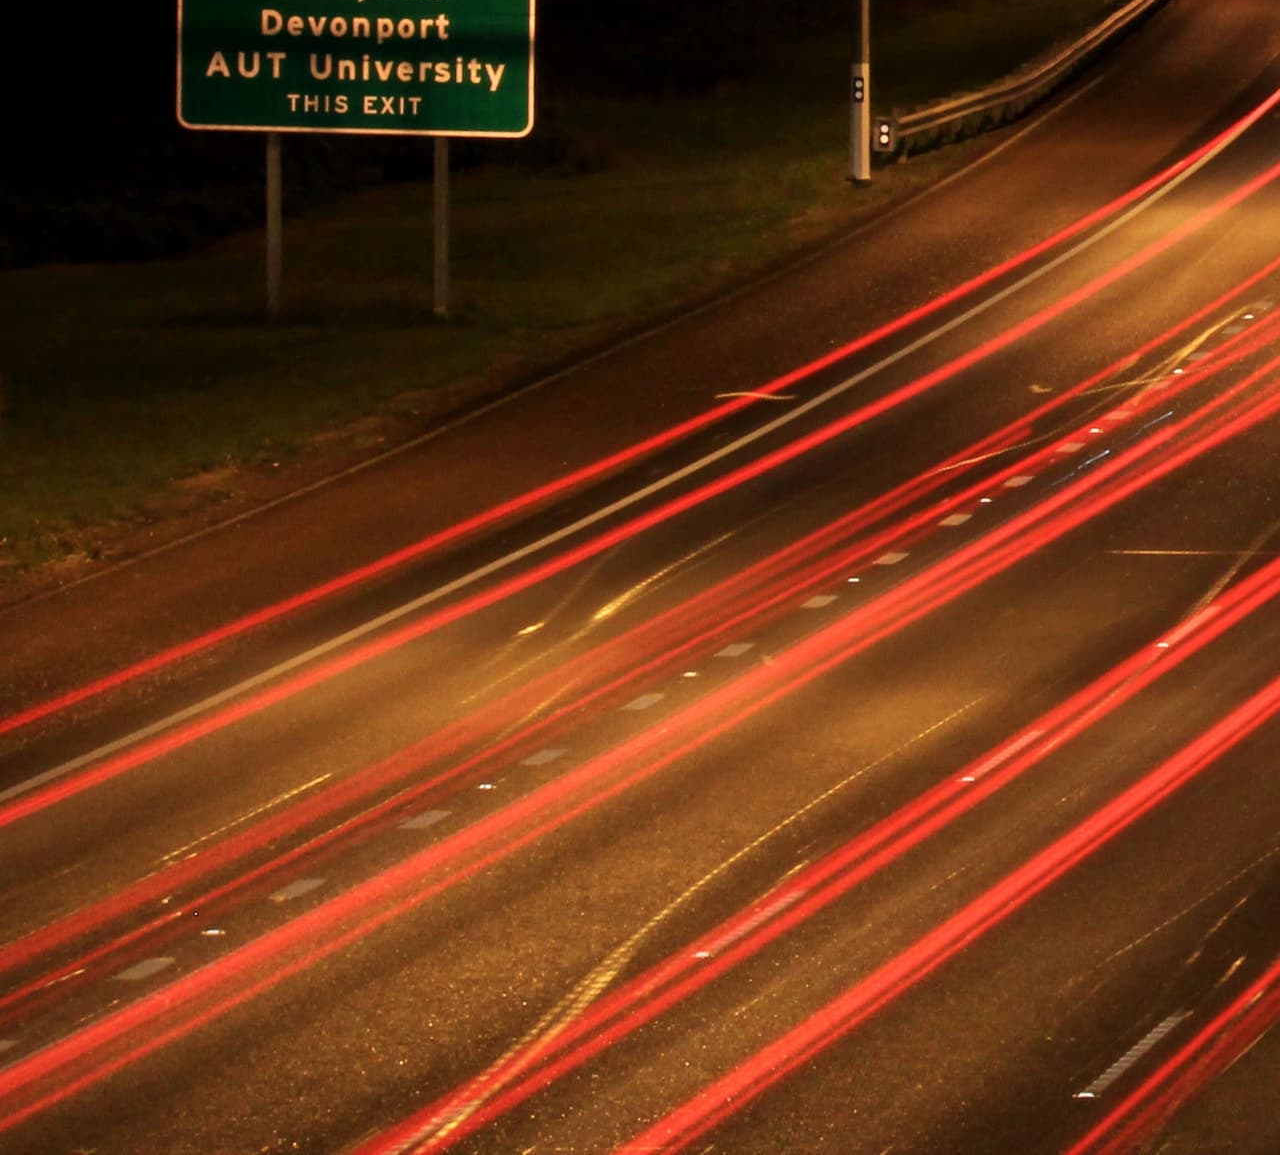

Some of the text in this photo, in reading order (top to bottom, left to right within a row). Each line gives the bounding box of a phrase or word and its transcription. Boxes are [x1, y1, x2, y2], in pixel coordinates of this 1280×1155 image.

[260, 9, 450, 44] Devonport
[205, 51, 505, 92] AUT University
[286, 93, 422, 115] THIS EXIT
